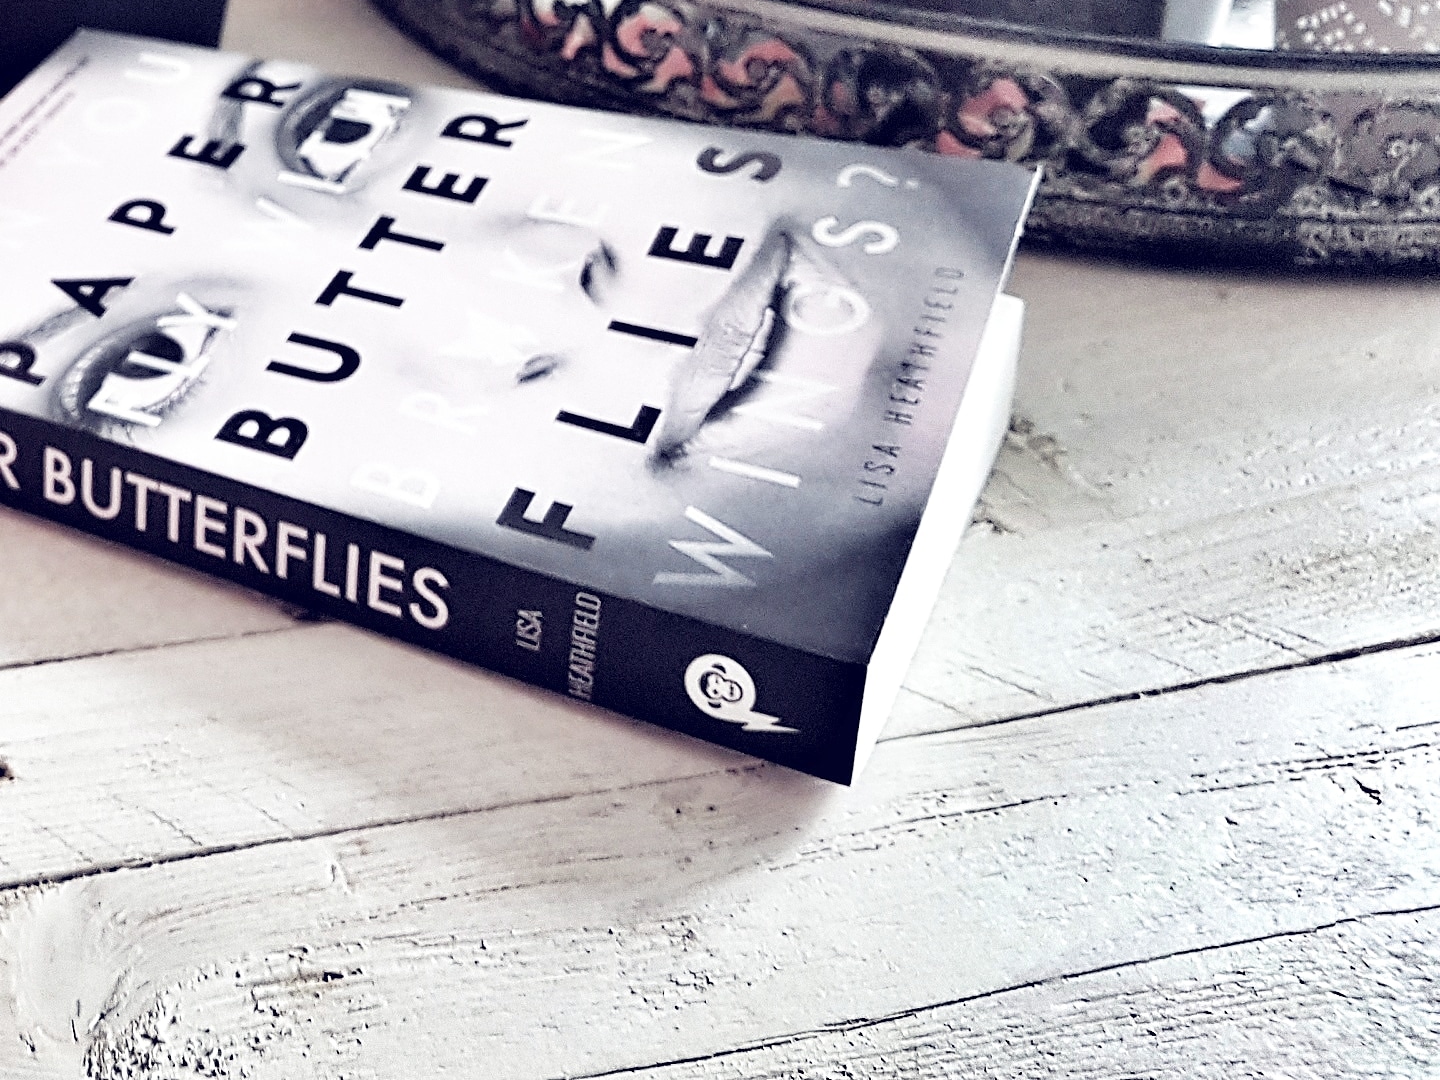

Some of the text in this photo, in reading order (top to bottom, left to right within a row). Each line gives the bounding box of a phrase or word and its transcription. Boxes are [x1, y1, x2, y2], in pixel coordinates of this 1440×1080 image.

[214, 111, 529, 462] BUTTER
[350, 126, 654, 510] BRKEN
[496, 144, 783, 551] FLIES
[853, 266, 965, 507] LISA HEATHFIELD
[42, 445, 453, 631] BUTTERFLIES
[515, 608, 545, 652] LISA
[568, 590, 602, 702] HEATHFIELD
